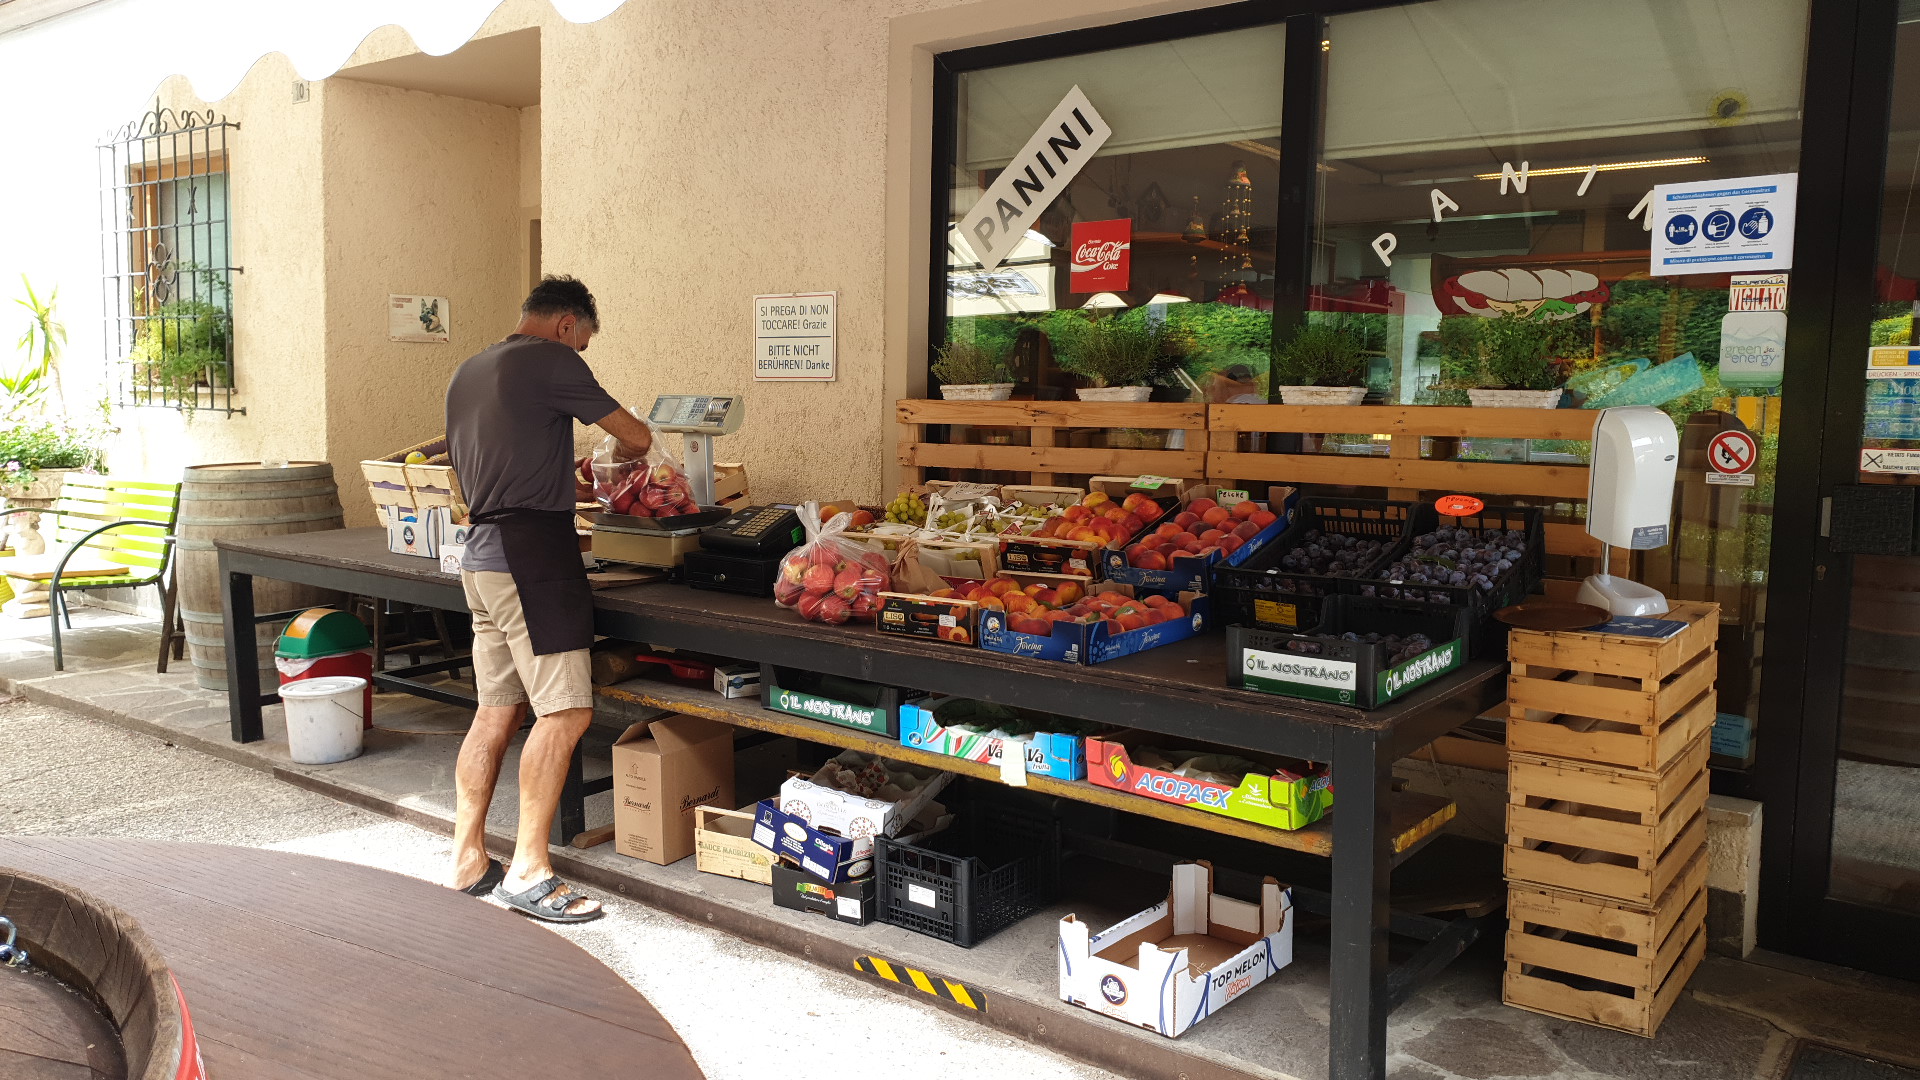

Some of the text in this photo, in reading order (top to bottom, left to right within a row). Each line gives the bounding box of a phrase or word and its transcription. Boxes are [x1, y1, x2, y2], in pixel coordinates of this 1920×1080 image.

[973, 107, 1094, 253] PANINI
[1730, 287, 1785, 310] VIGILATO
[761, 304, 829, 317] SI PREGA DI NON
[762, 319, 827, 330] TOCCARE! Grazie
[768, 345, 820, 356] BITTE NICHT
[1725, 345, 1762, 359] green
[758, 357, 830, 370] BERÜHREN! Danke
[1731, 354, 1777, 366] energy
[1271, 662, 1351, 681] NOSTRANO
[803, 698, 873, 726] NOSTRANO
[680, 785, 720, 810] Bernardi
[1135, 773, 1234, 809] ACOPAEX
[623, 796, 652, 809] Bernardi
[722, 846, 756, 859] MAURIZIO
[1212, 970, 1232, 991] TOP
[1234, 948, 1266, 979] MELON
